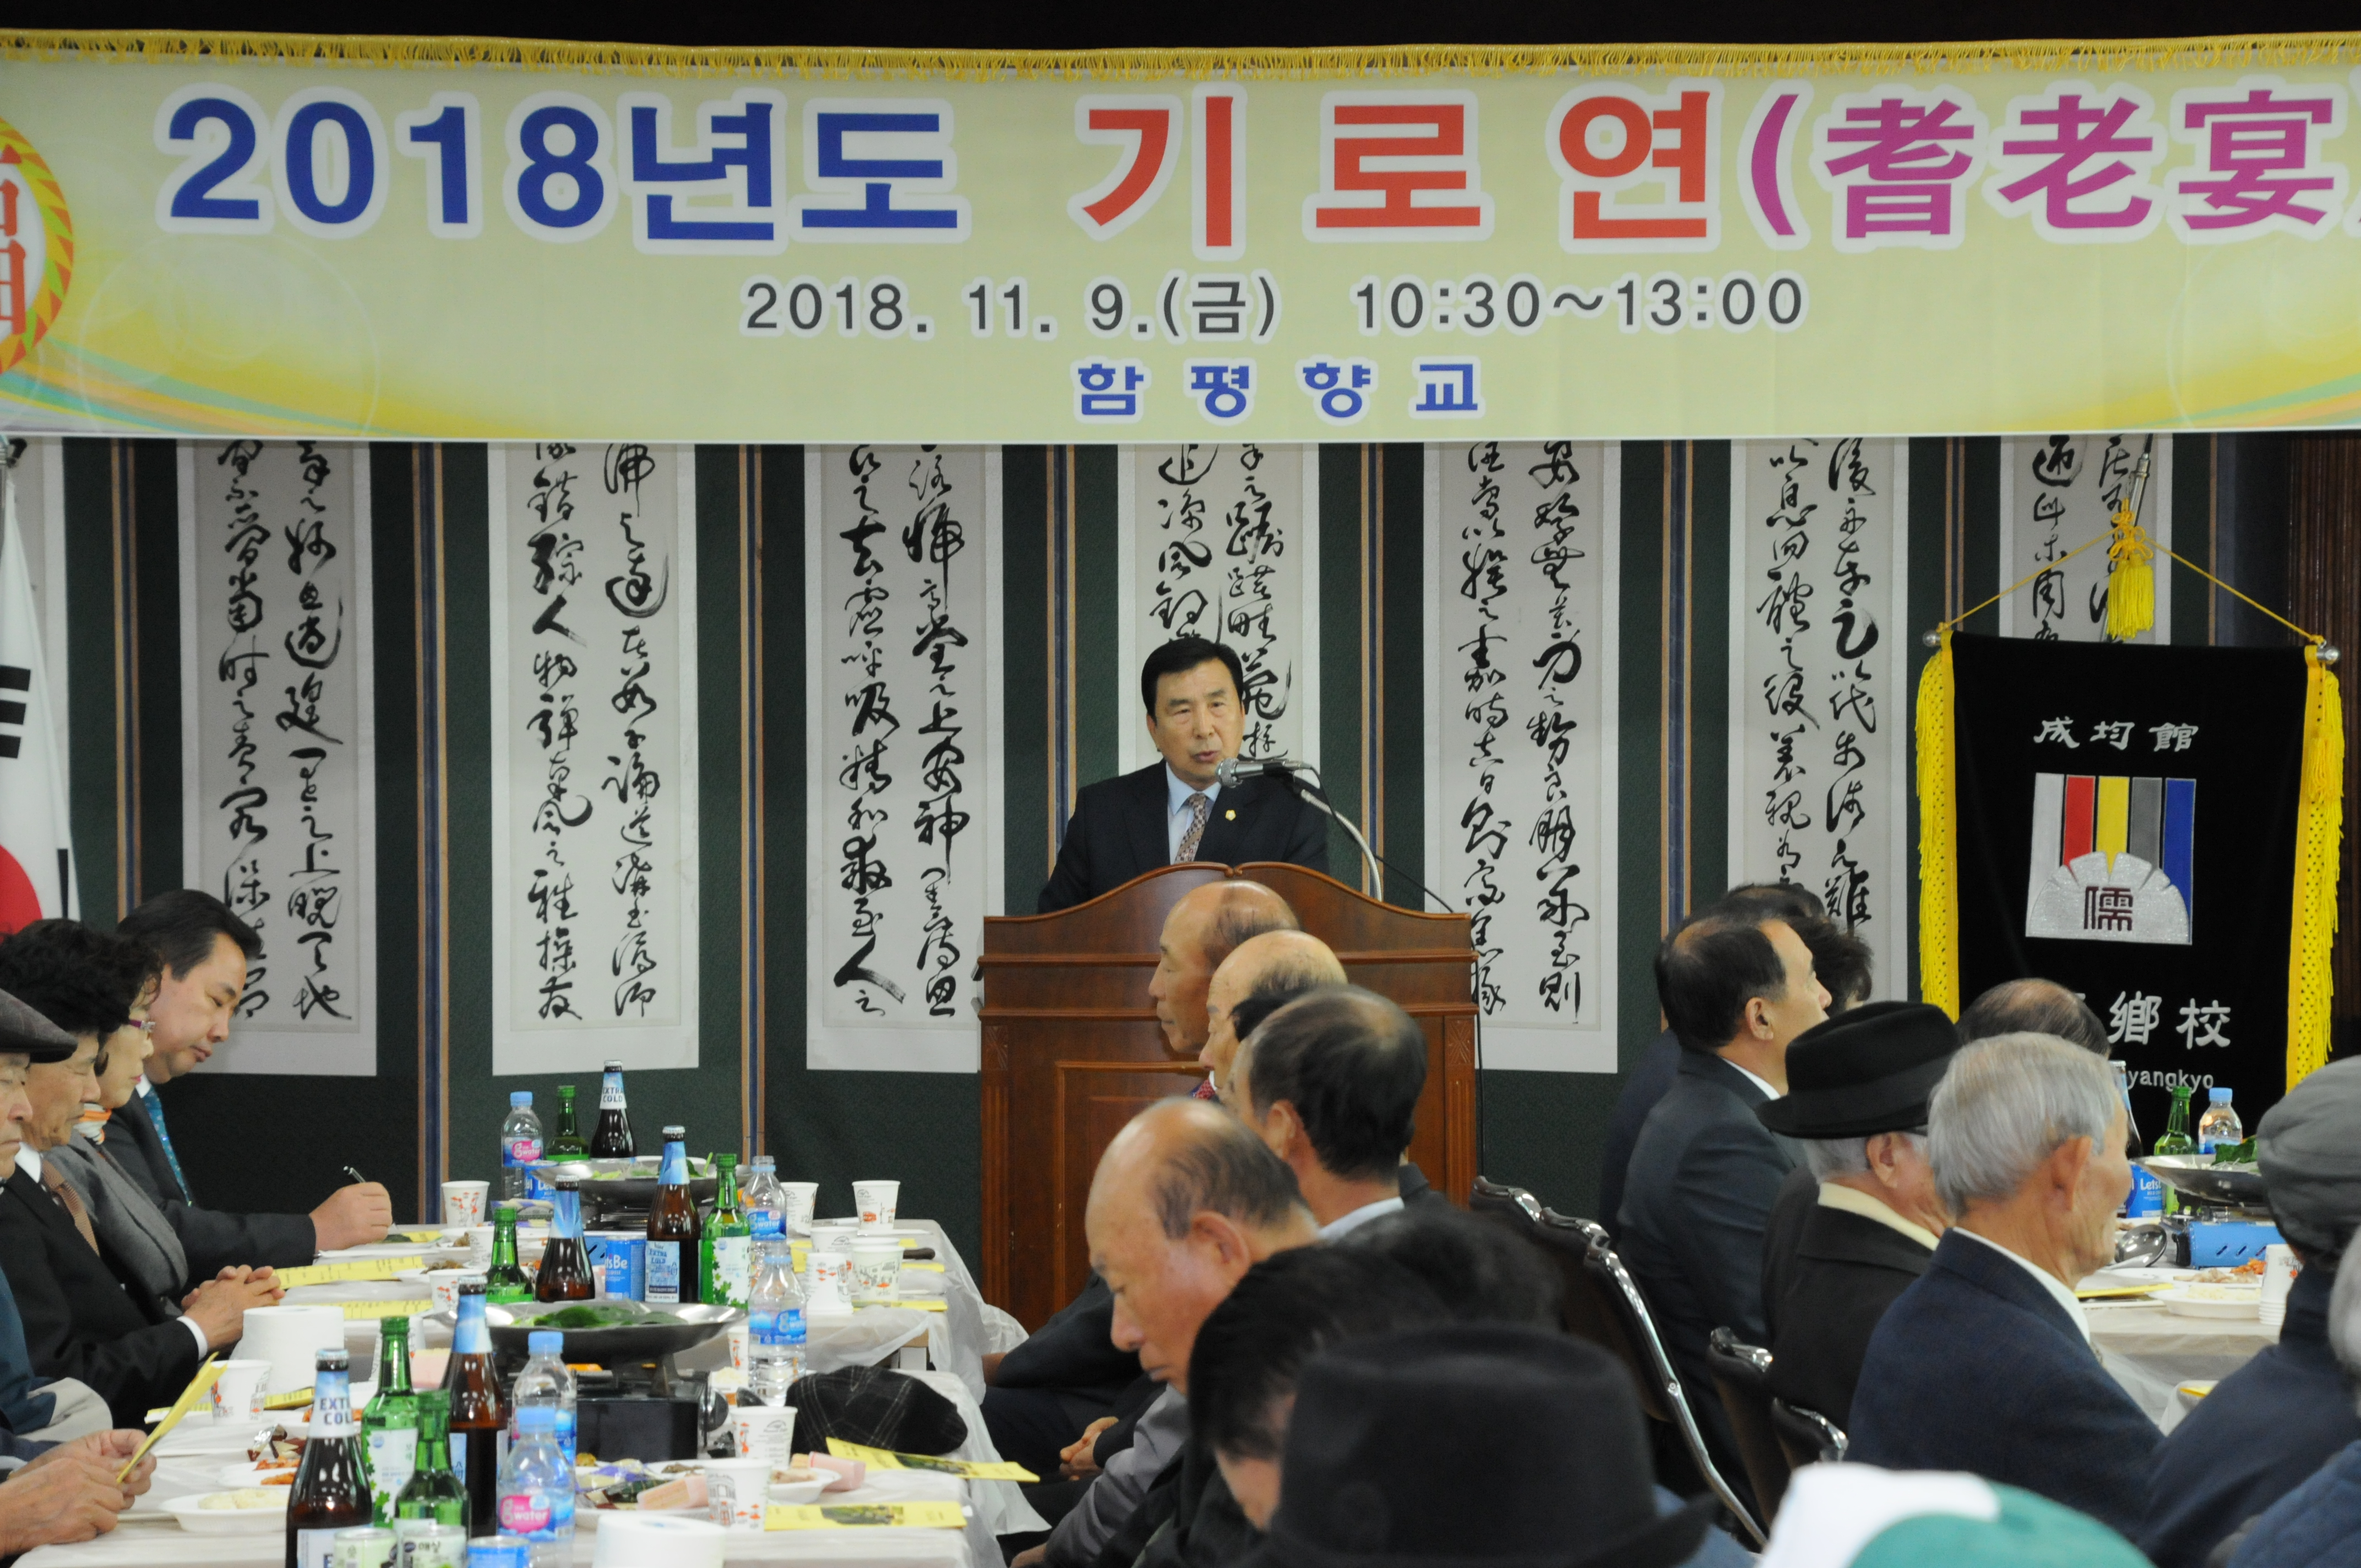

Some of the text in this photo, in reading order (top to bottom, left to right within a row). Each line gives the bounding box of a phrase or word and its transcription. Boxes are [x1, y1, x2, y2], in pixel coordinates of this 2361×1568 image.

[170, 97, 958, 240] 2018년도
[747, 282, 928, 334] 2018.
[969, 284, 1051, 333] 11.
[2033, 716, 2199, 753] 成均館
[2083, 886, 2134, 932] 儒
[2128, 1069, 2214, 1095] yangkyo
[2140, 1177, 2161, 1191] Lets
[323, 1412, 353, 1425] COL
